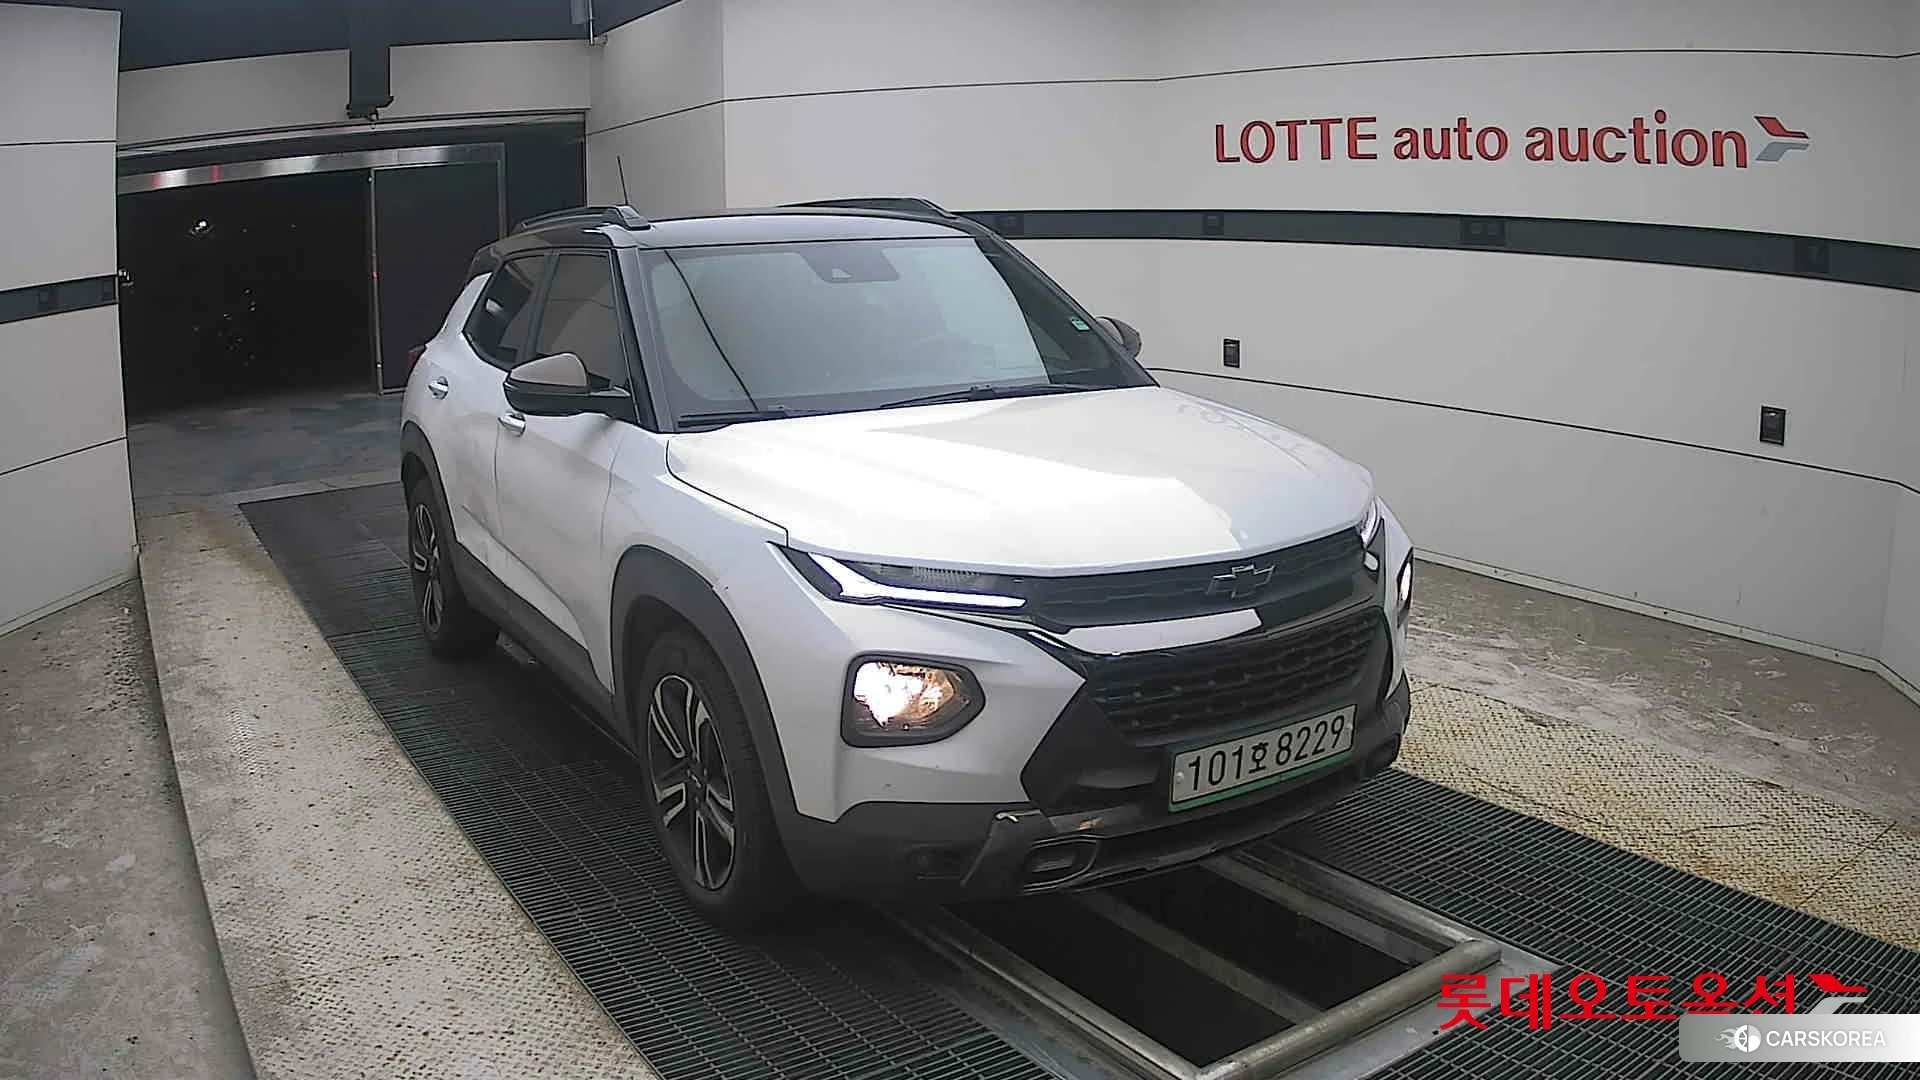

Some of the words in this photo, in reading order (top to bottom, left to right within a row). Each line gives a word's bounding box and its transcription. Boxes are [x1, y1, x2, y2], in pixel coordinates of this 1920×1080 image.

[1215, 117, 1377, 163] LOTTE
[1393, 117, 1509, 161] auto
[1525, 109, 1748, 168] auction
